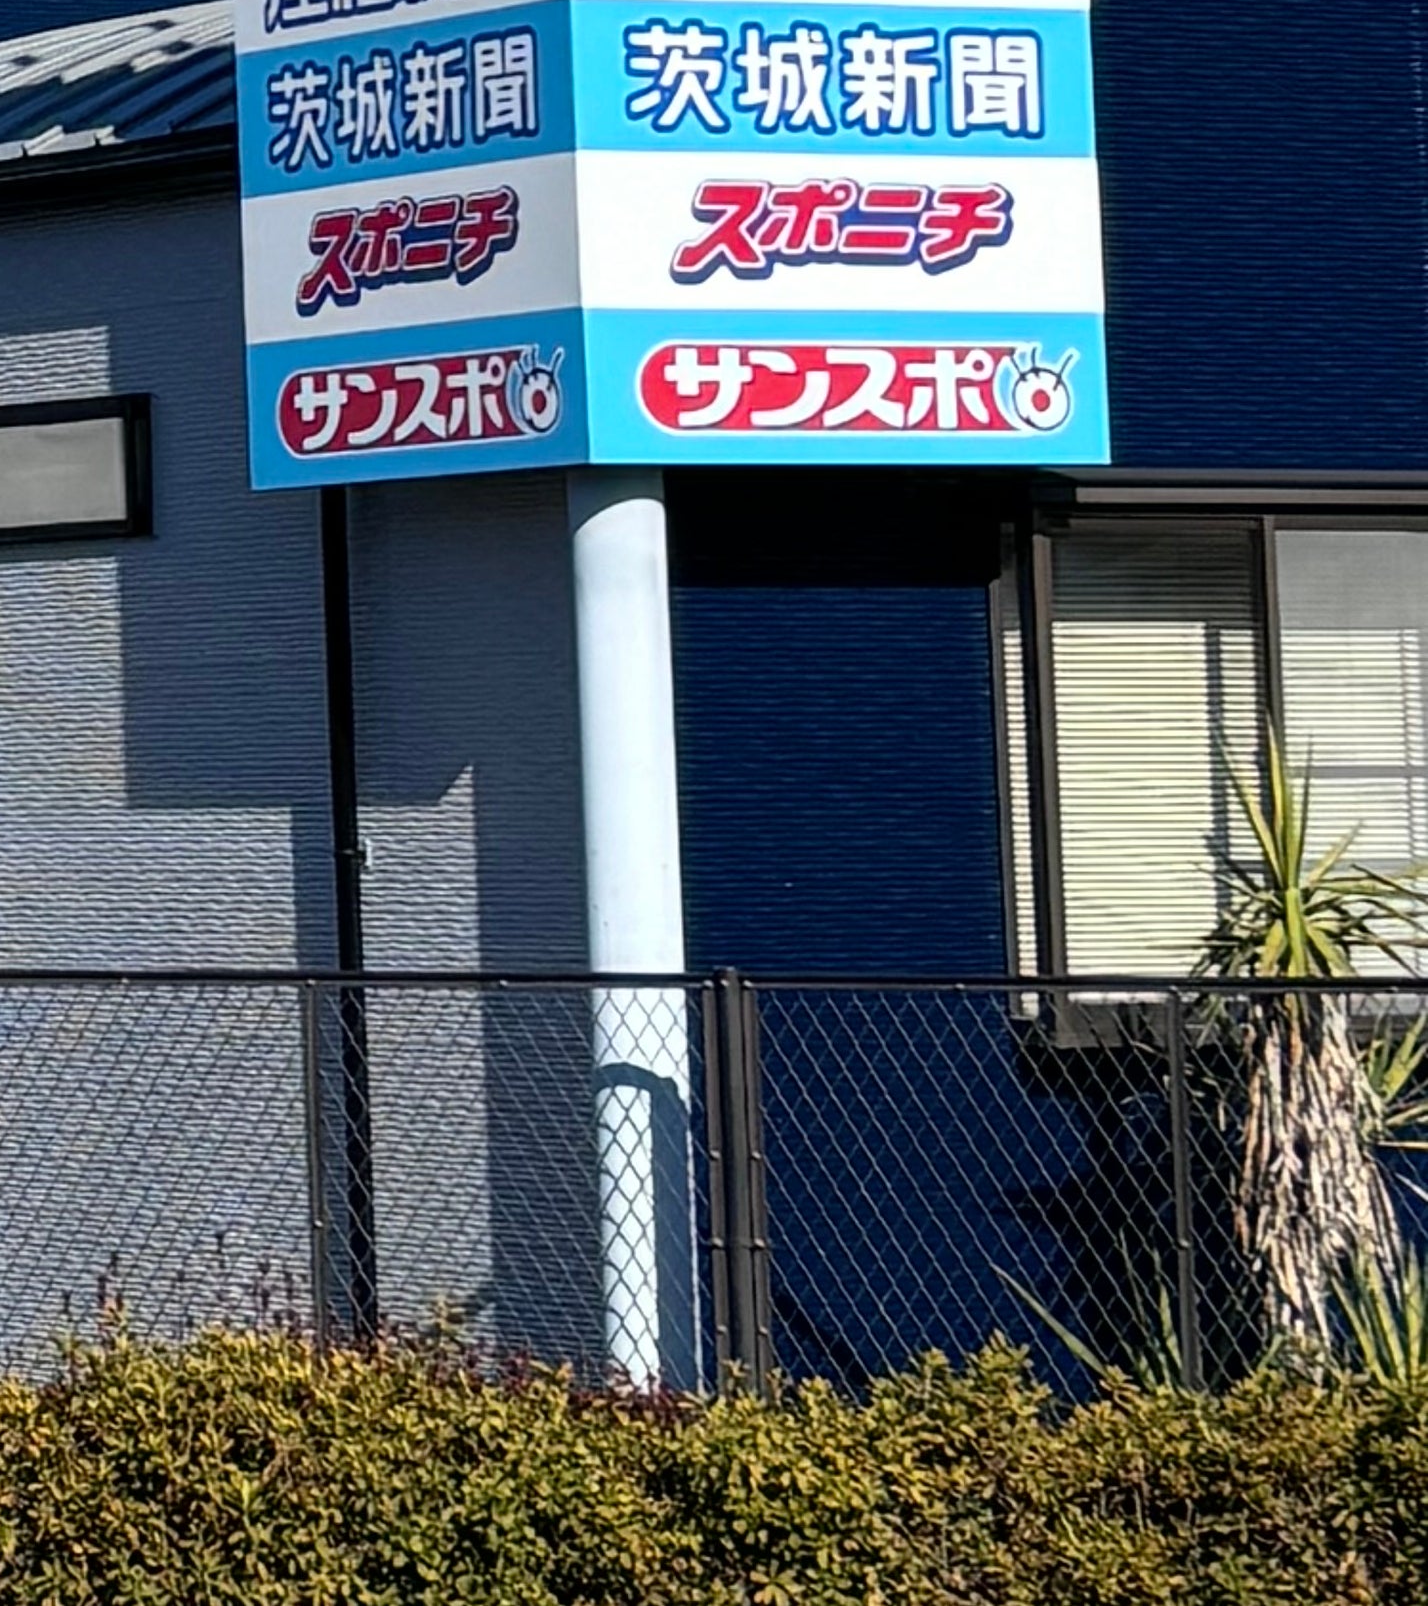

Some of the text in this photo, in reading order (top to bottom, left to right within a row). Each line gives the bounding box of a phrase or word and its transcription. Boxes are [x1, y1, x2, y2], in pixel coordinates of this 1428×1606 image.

[267, 27, 539, 172] 茨城新聞
[624, 17, 1044, 139] 茨城新聞
[296, 185, 518, 316] スポニチ
[670, 178, 1013, 284] スポニチ
[294, 356, 505, 450] サンスポ
[664, 347, 993, 427] サンスポ
